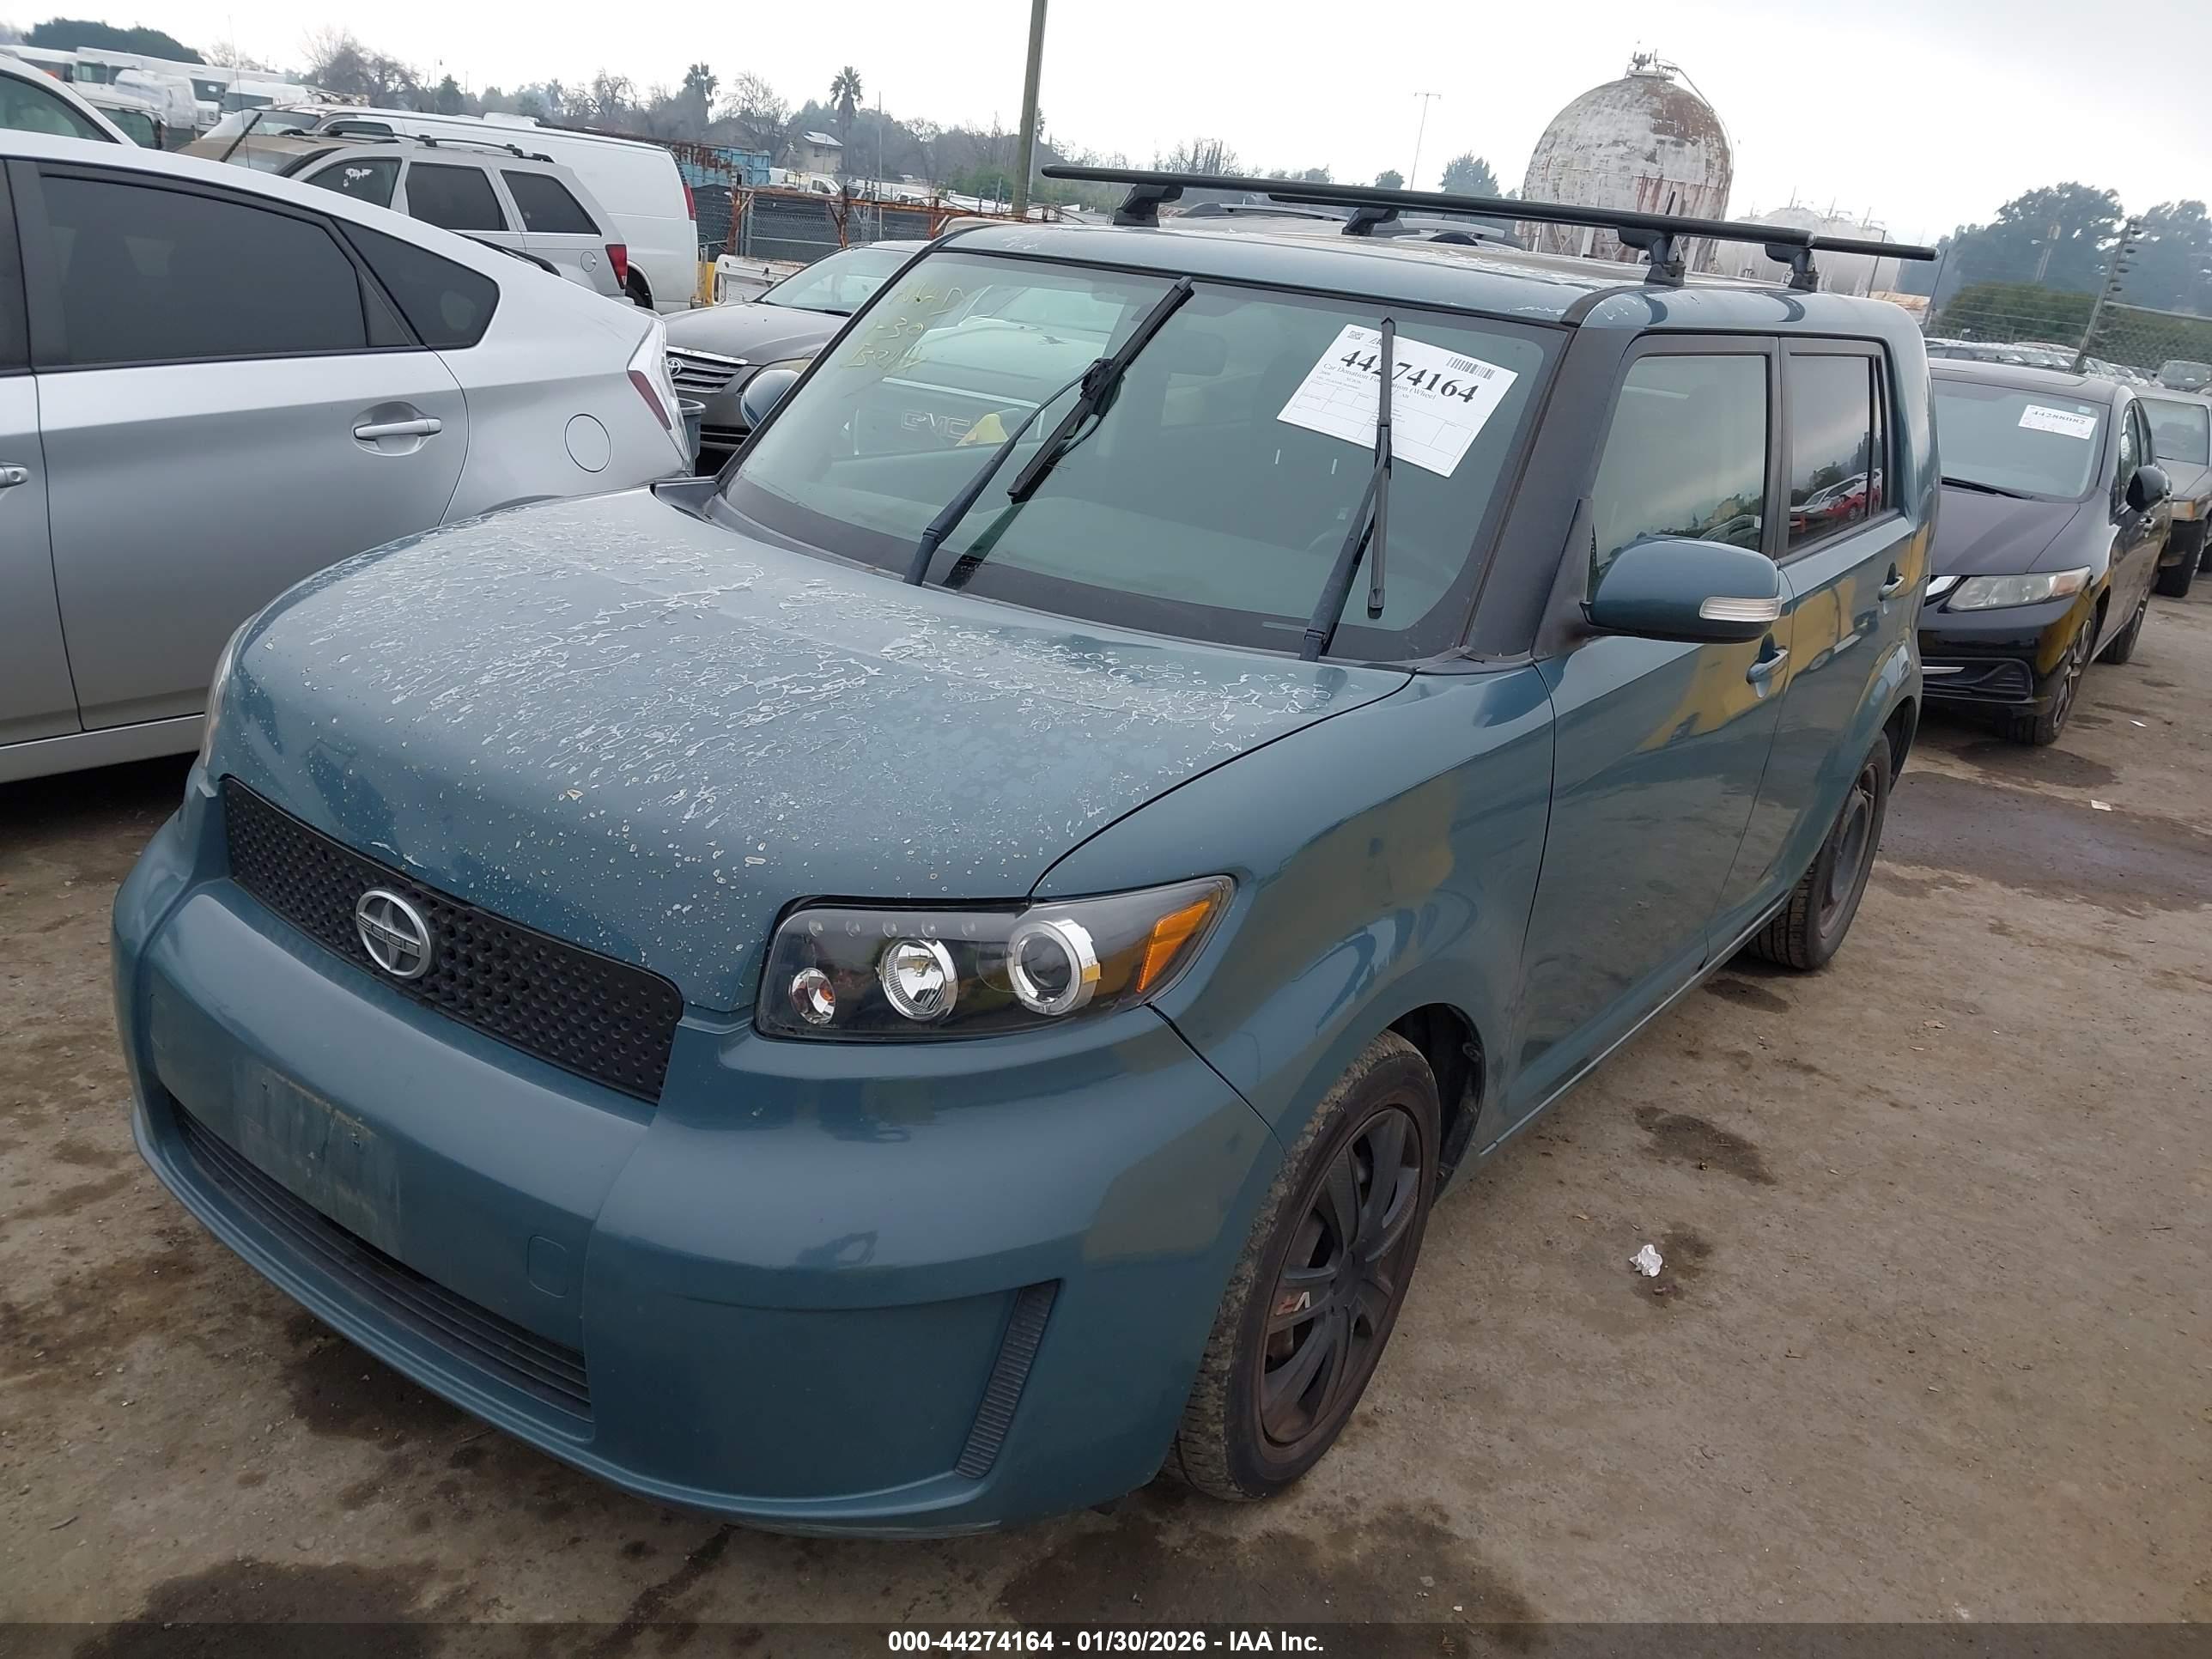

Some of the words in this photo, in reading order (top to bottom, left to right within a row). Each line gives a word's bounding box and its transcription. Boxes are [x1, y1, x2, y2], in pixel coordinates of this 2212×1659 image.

[1322, 362, 1335, 371] Car
[1337, 365, 1369, 380] Donation
[901, 409, 970, 440] GMC
